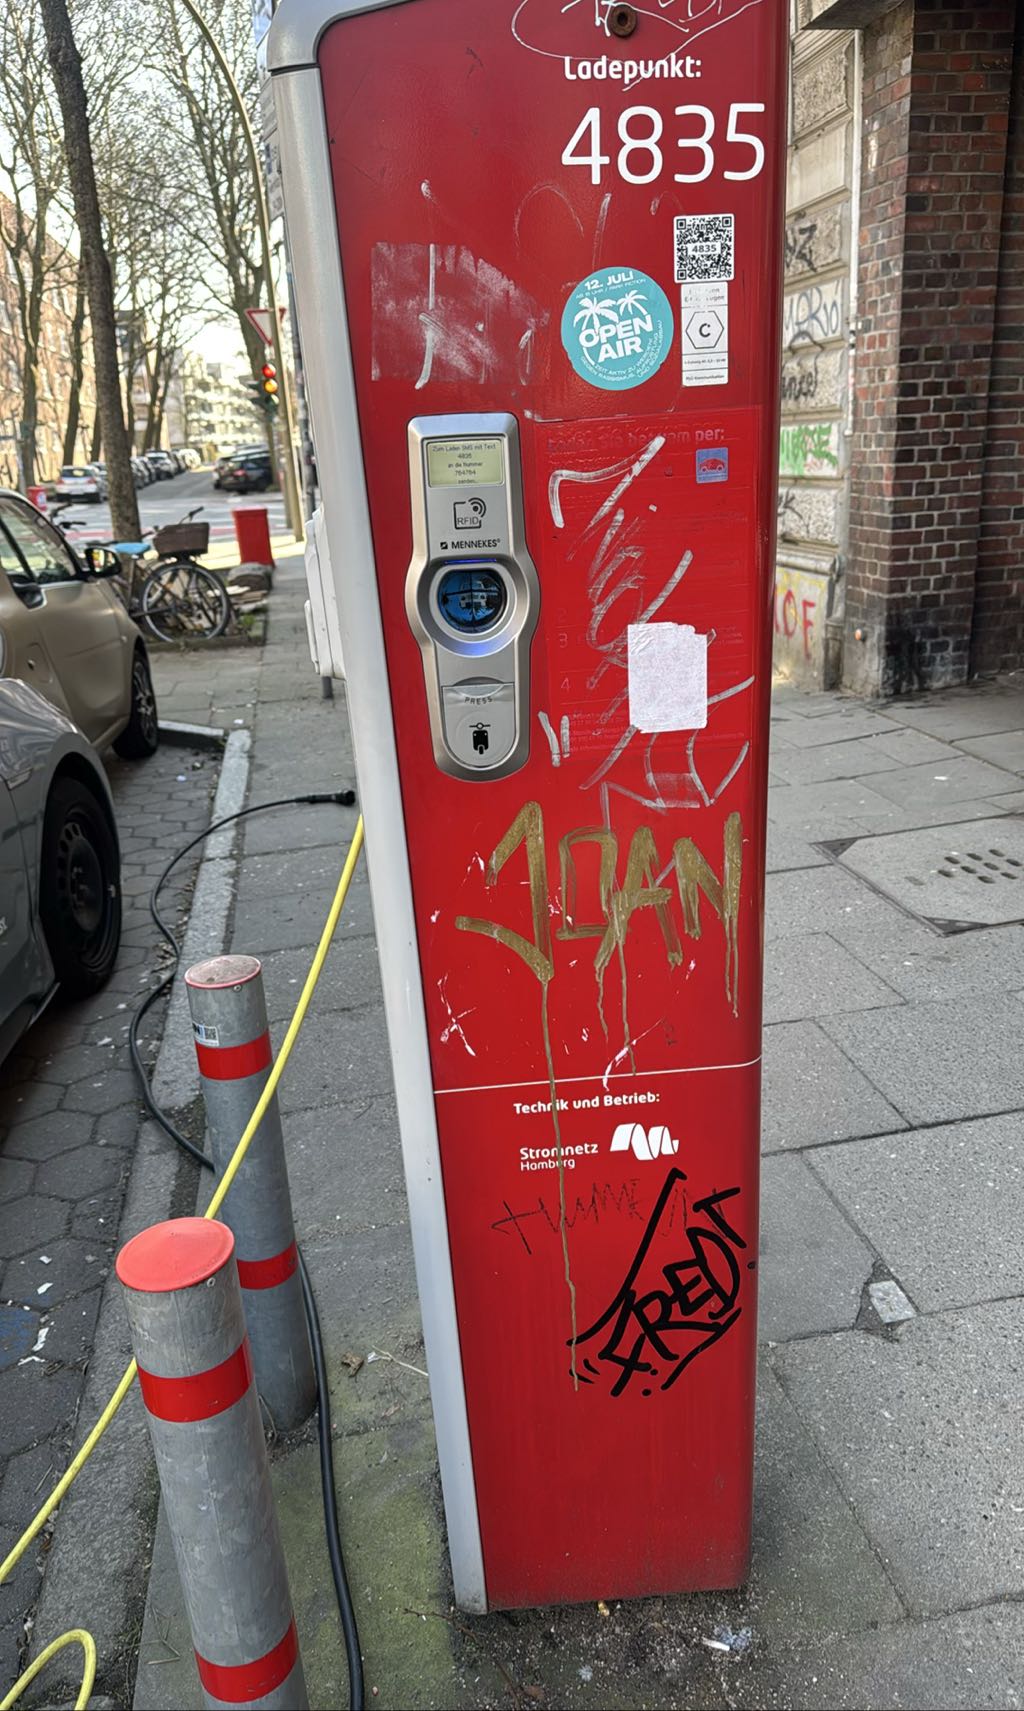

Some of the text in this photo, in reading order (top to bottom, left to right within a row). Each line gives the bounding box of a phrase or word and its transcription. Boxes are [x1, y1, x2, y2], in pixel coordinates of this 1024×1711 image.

[564, 54, 702, 84] Ladepunkt:
[561, 103, 765, 185] 4835
[691, 243, 717, 254] 4835
[584, 270, 634, 291] 12. JULI
[579, 314, 653, 347] OPEN
[699, 322, 711, 338] C
[597, 336, 644, 363] AIR
[695, 427, 725, 442] per:
[456, 516, 479, 526] RFID
[560, 632, 568, 649] 3
[561, 677, 571, 692] 4
[464, 696, 493, 706] PRESS
[513, 1091, 660, 1115] Technik und Betrieb:
[519, 1142, 599, 1160] Stromnetz
